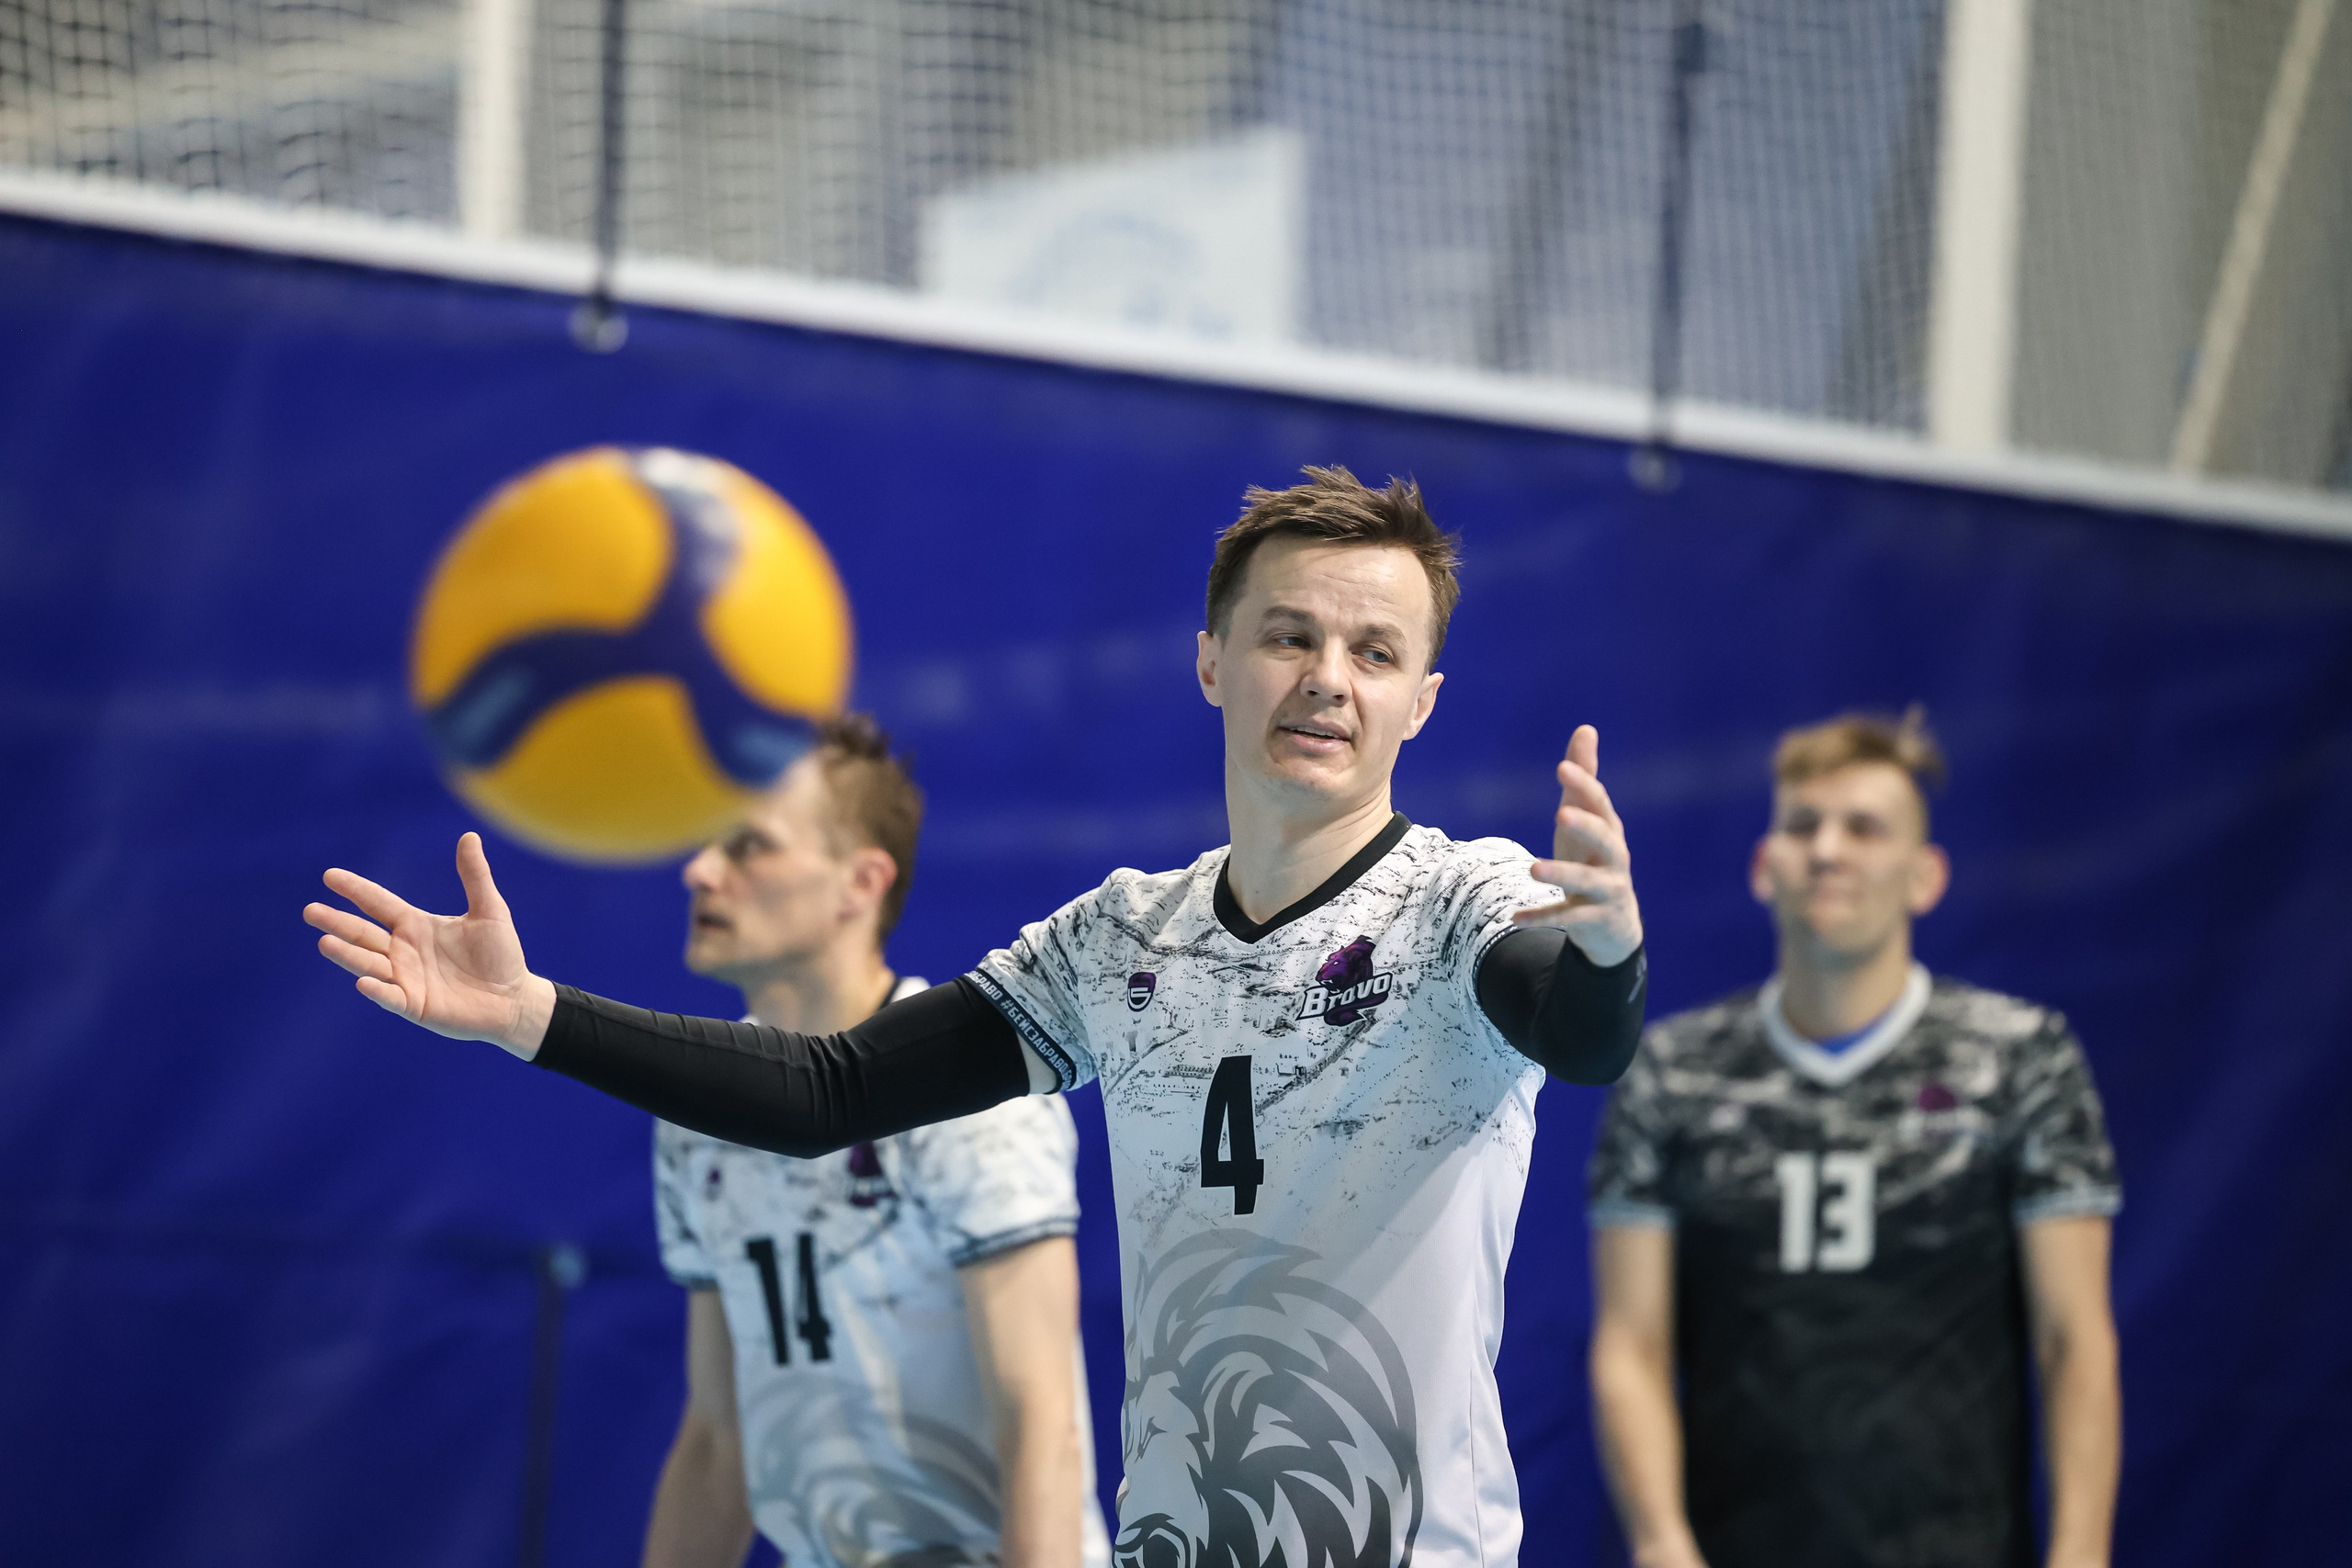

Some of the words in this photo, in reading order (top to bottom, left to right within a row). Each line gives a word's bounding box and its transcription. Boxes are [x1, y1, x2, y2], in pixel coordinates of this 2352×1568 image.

[1298, 973, 1392, 1020] Bravo
[1200, 1055, 1264, 1215] 4
[1774, 1150, 1876, 1274] 13
[744, 1231, 832, 1367] 14
